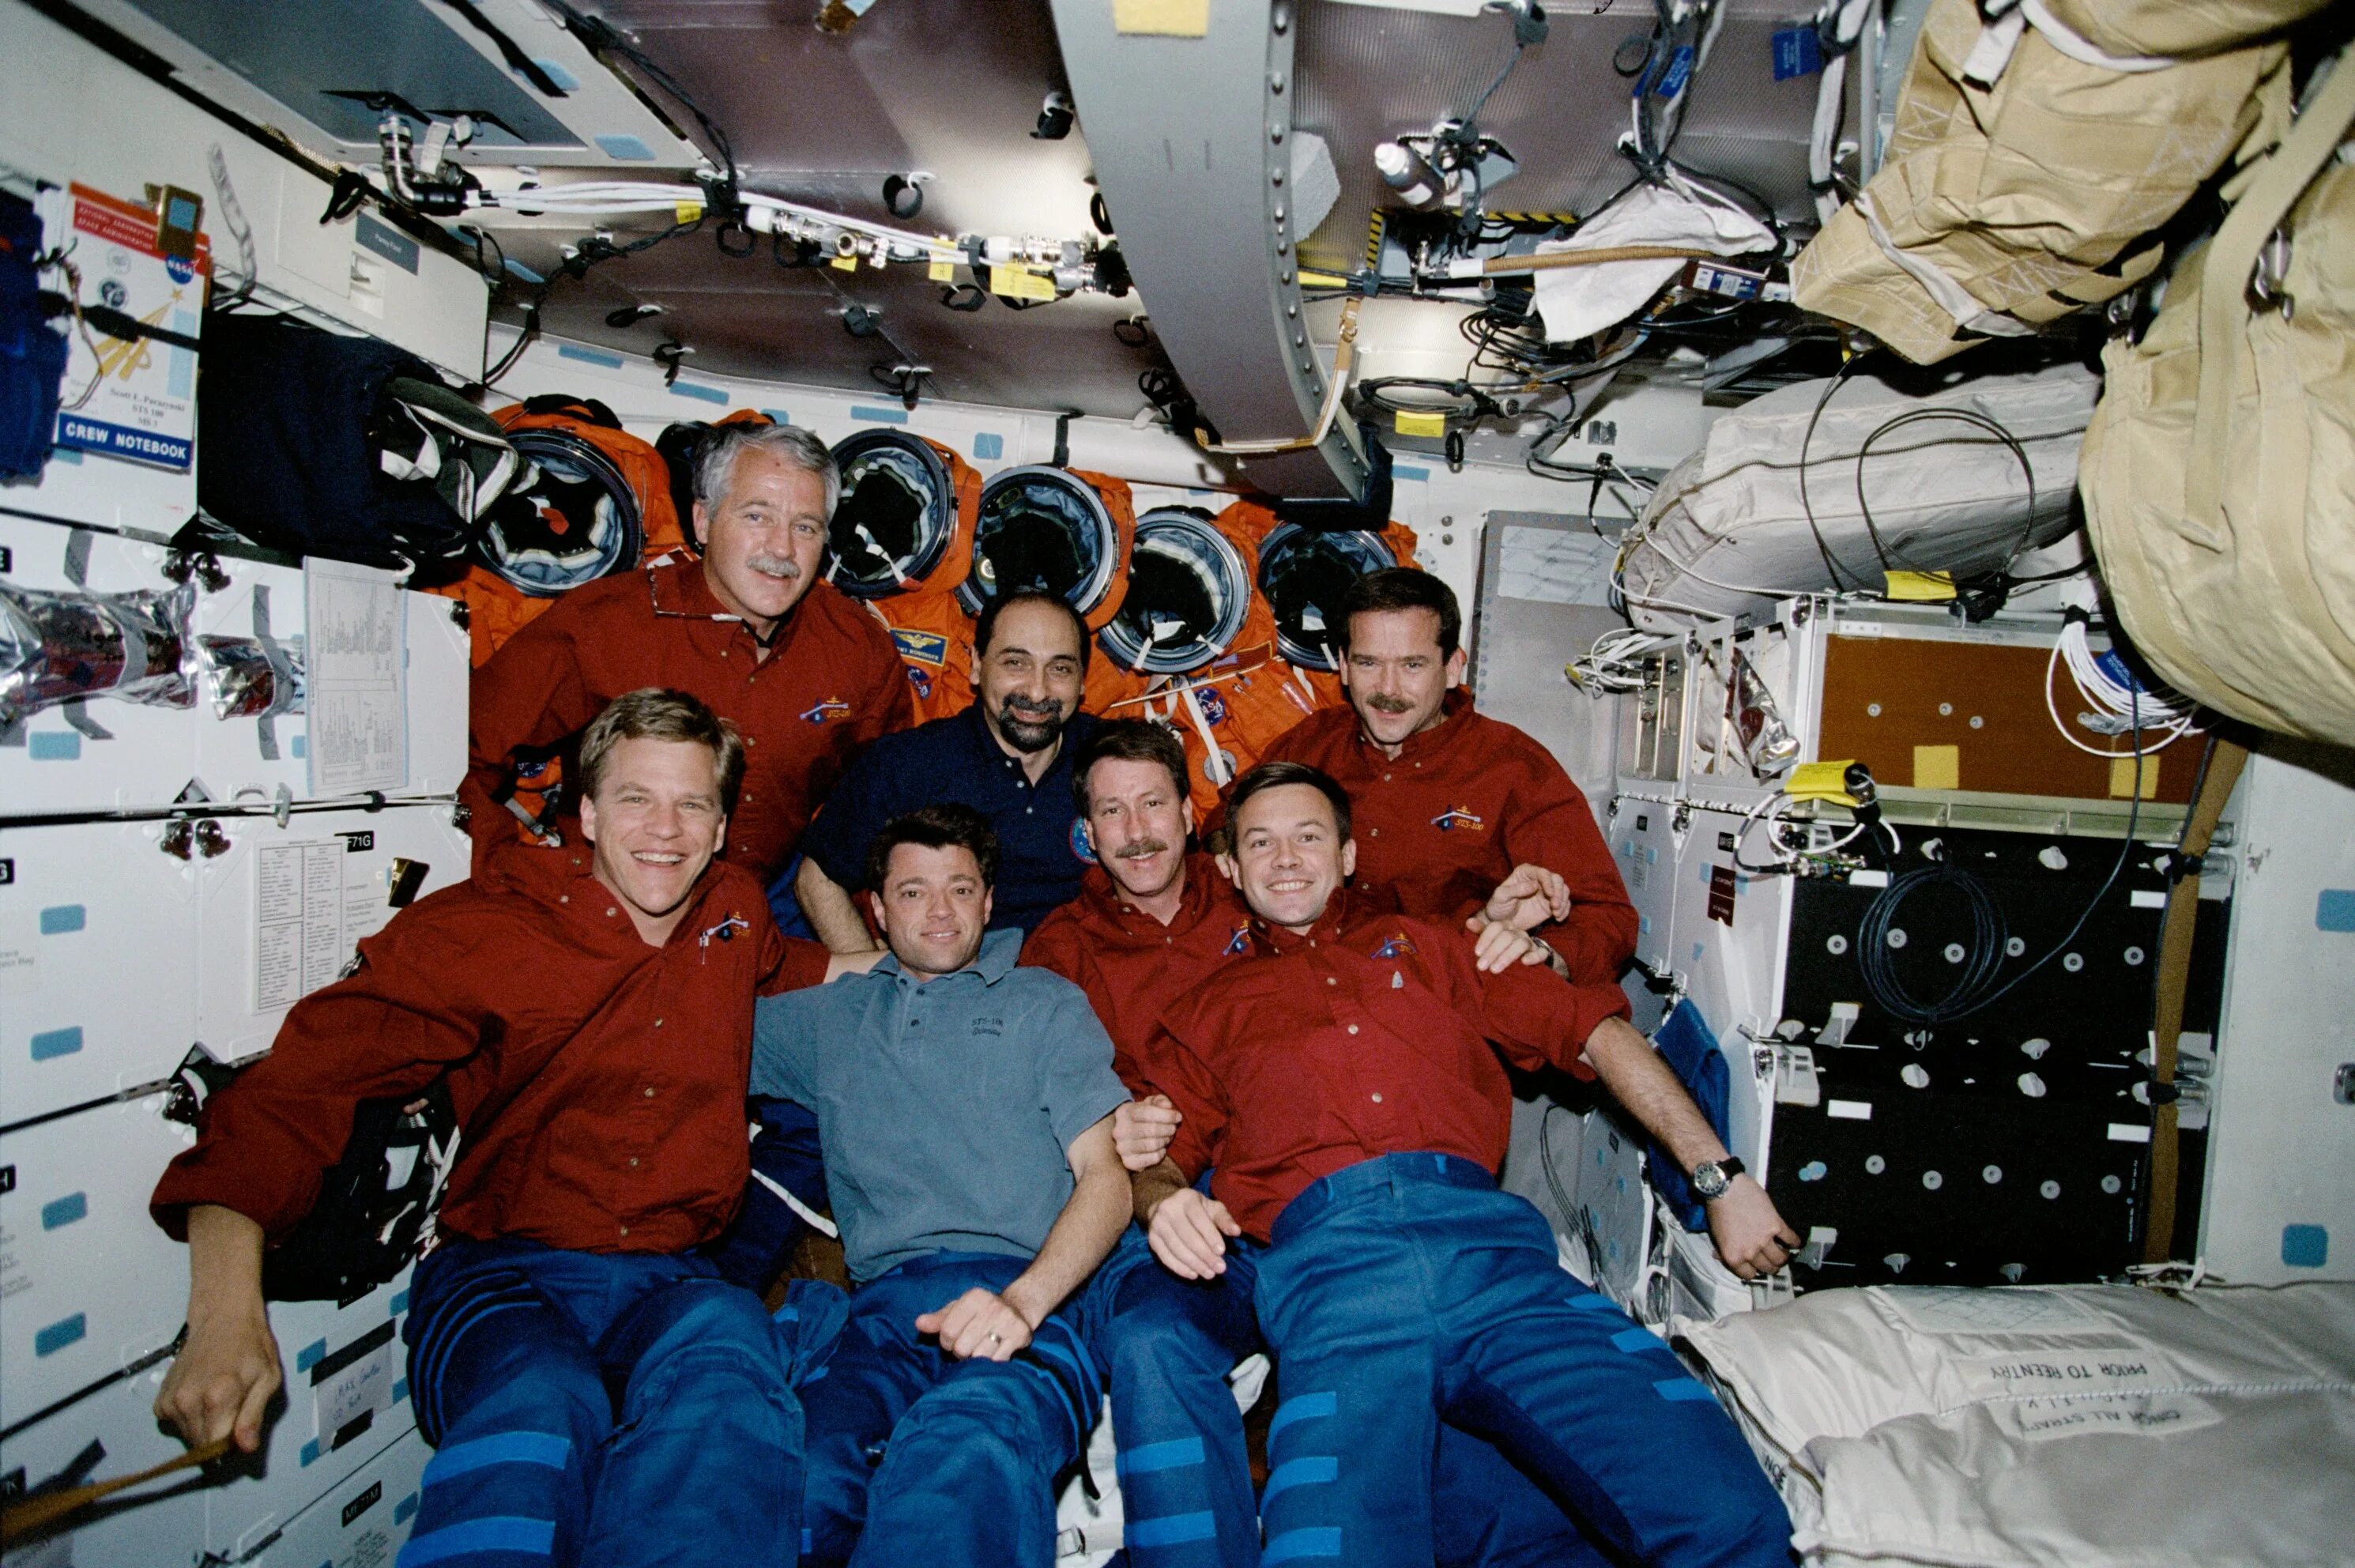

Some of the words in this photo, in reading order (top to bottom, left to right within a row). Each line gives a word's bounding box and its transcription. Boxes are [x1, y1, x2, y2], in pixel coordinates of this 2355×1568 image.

[77, 217, 99, 230] SPACE
[167, 258, 193, 276] NASA
[111, 388, 130, 399] Scott
[65, 422, 109, 443] CREW
[115, 432, 187, 460] NOTEBOOK
[910, 648, 940, 661] ROMINGER
[1455, 819, 1484, 831] STS-100
[1991, 1363, 2063, 1379] REENTRY
[2067, 1364, 2093, 1379] TO
[2098, 1362, 2148, 1377] PRIOR
[2092, 1411, 2121, 1421] ALL
